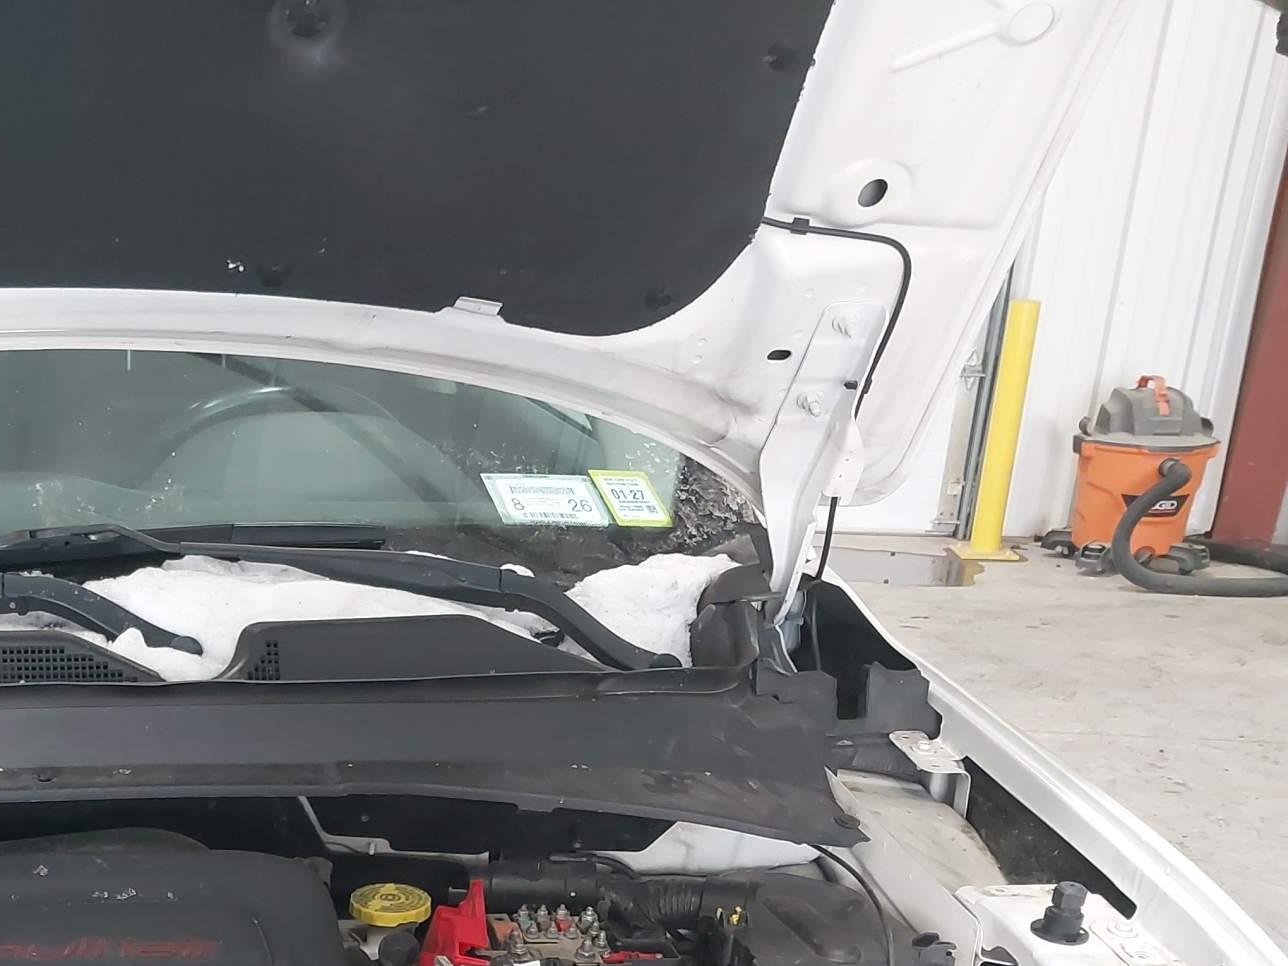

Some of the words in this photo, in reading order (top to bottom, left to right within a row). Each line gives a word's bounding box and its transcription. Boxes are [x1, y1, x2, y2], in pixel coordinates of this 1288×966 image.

[611, 488, 645, 500] 01-27
[511, 498, 525, 511] 8
[568, 499, 593, 513] 26
